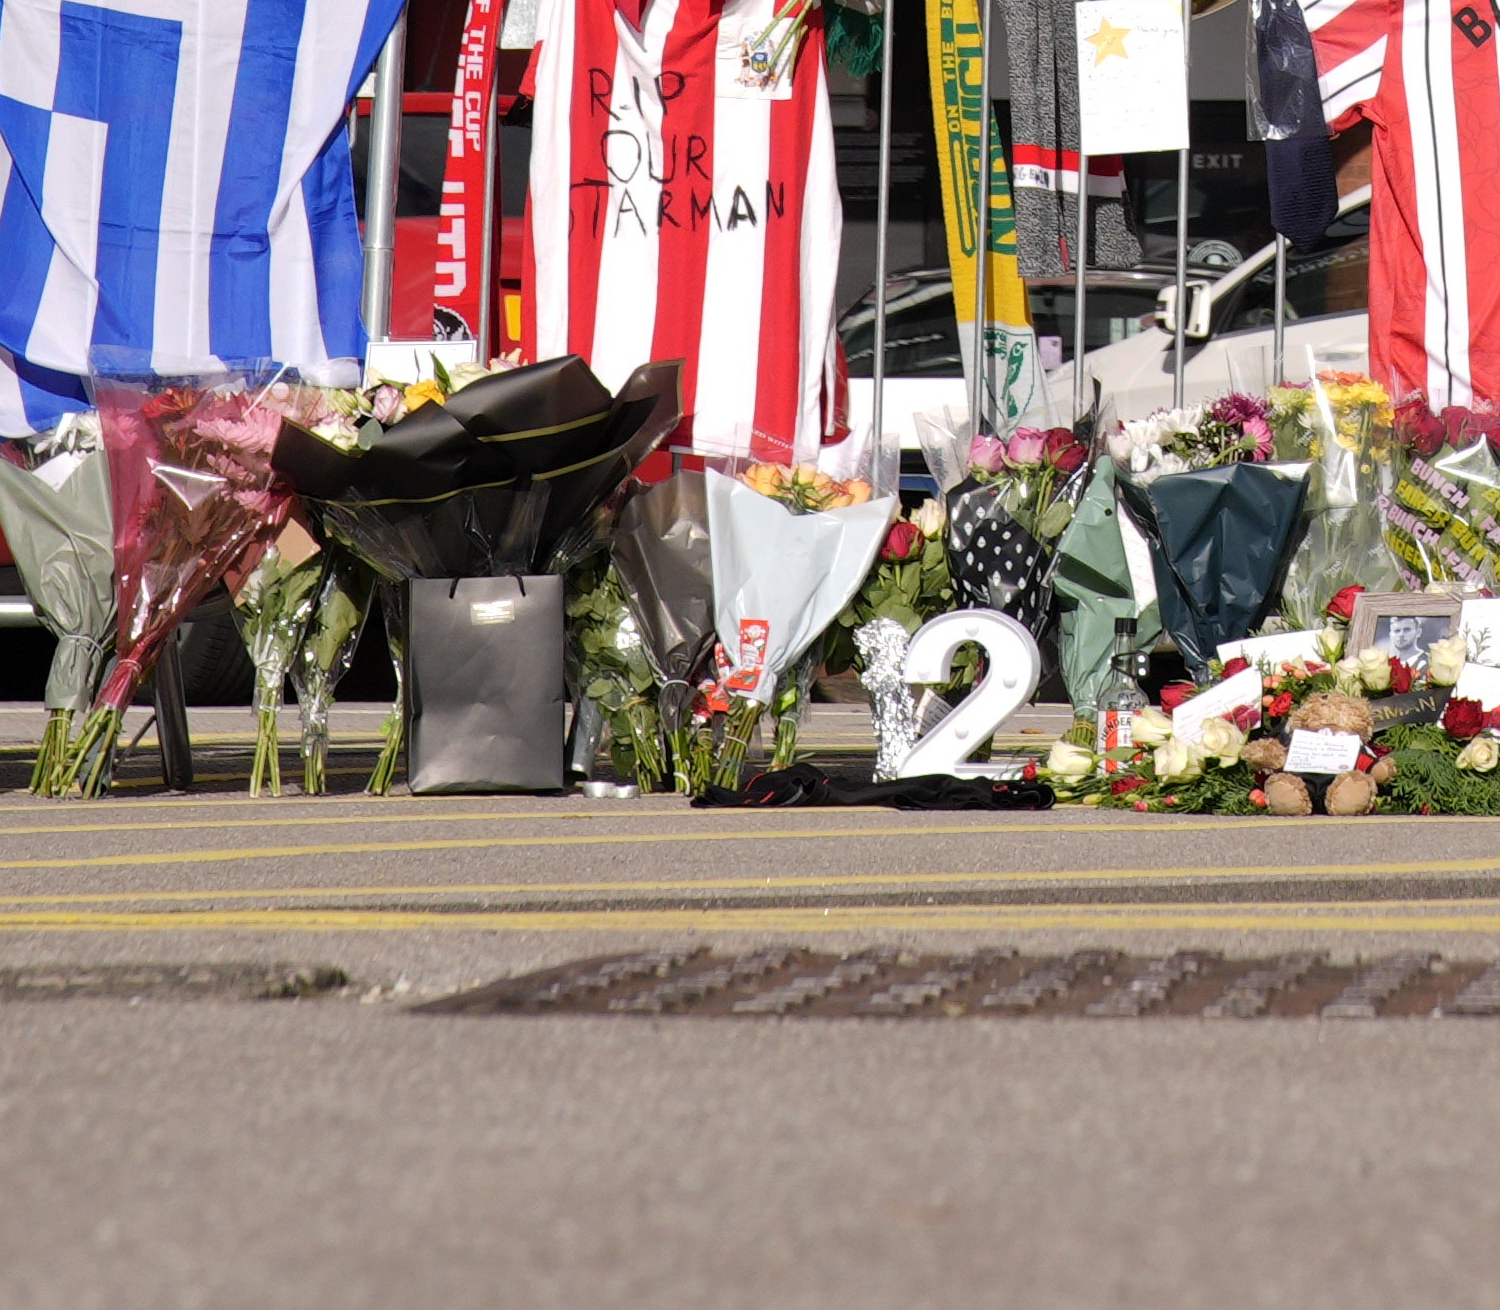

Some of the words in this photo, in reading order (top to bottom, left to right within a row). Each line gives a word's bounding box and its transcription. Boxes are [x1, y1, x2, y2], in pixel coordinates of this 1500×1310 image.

[464, 24, 486, 81] THE
[941, 36, 956, 84] THE
[463, 90, 483, 152] CUP
[589, 68, 686, 122] RIP
[947, 104, 960, 133] ON
[601, 129, 712, 184] OUR
[1192, 153, 1243, 169] EXIT
[569, 178, 787, 240] TARMAN
[1410, 457, 1471, 510] BUNCH
[1387, 503, 1441, 547] BUNCH
[896, 609, 1041, 781] 2
